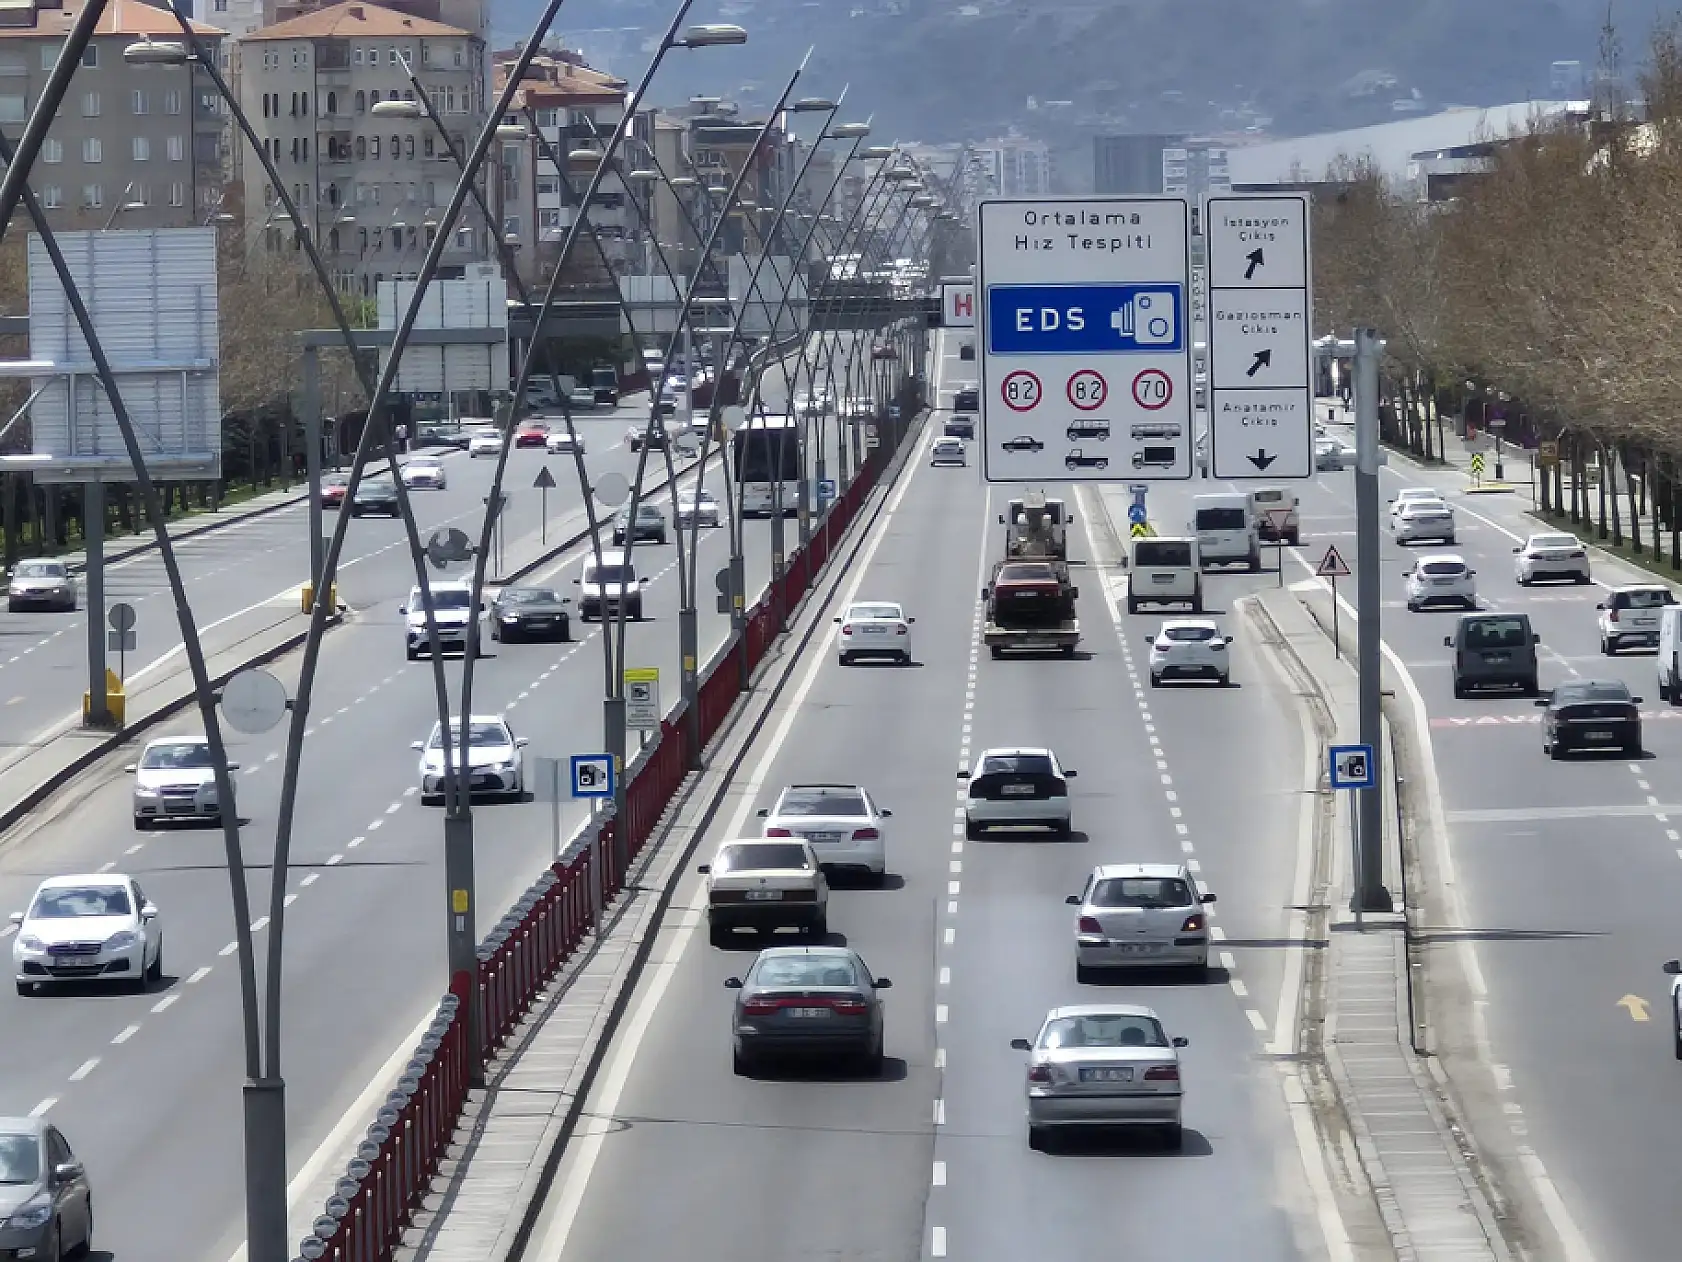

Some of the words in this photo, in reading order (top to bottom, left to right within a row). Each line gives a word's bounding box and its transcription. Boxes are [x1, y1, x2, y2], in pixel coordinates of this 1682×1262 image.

[1024, 209, 1140, 226] Ortalama
[1015, 234, 1054, 250] Hız
[1067, 233, 1152, 253] Tespiti
[954, 293, 973, 317] H
[1016, 306, 1085, 332] EDS
[1008, 380, 1034, 400] 82
[1075, 380, 1102, 400] 82
[1140, 379, 1166, 398] 70
